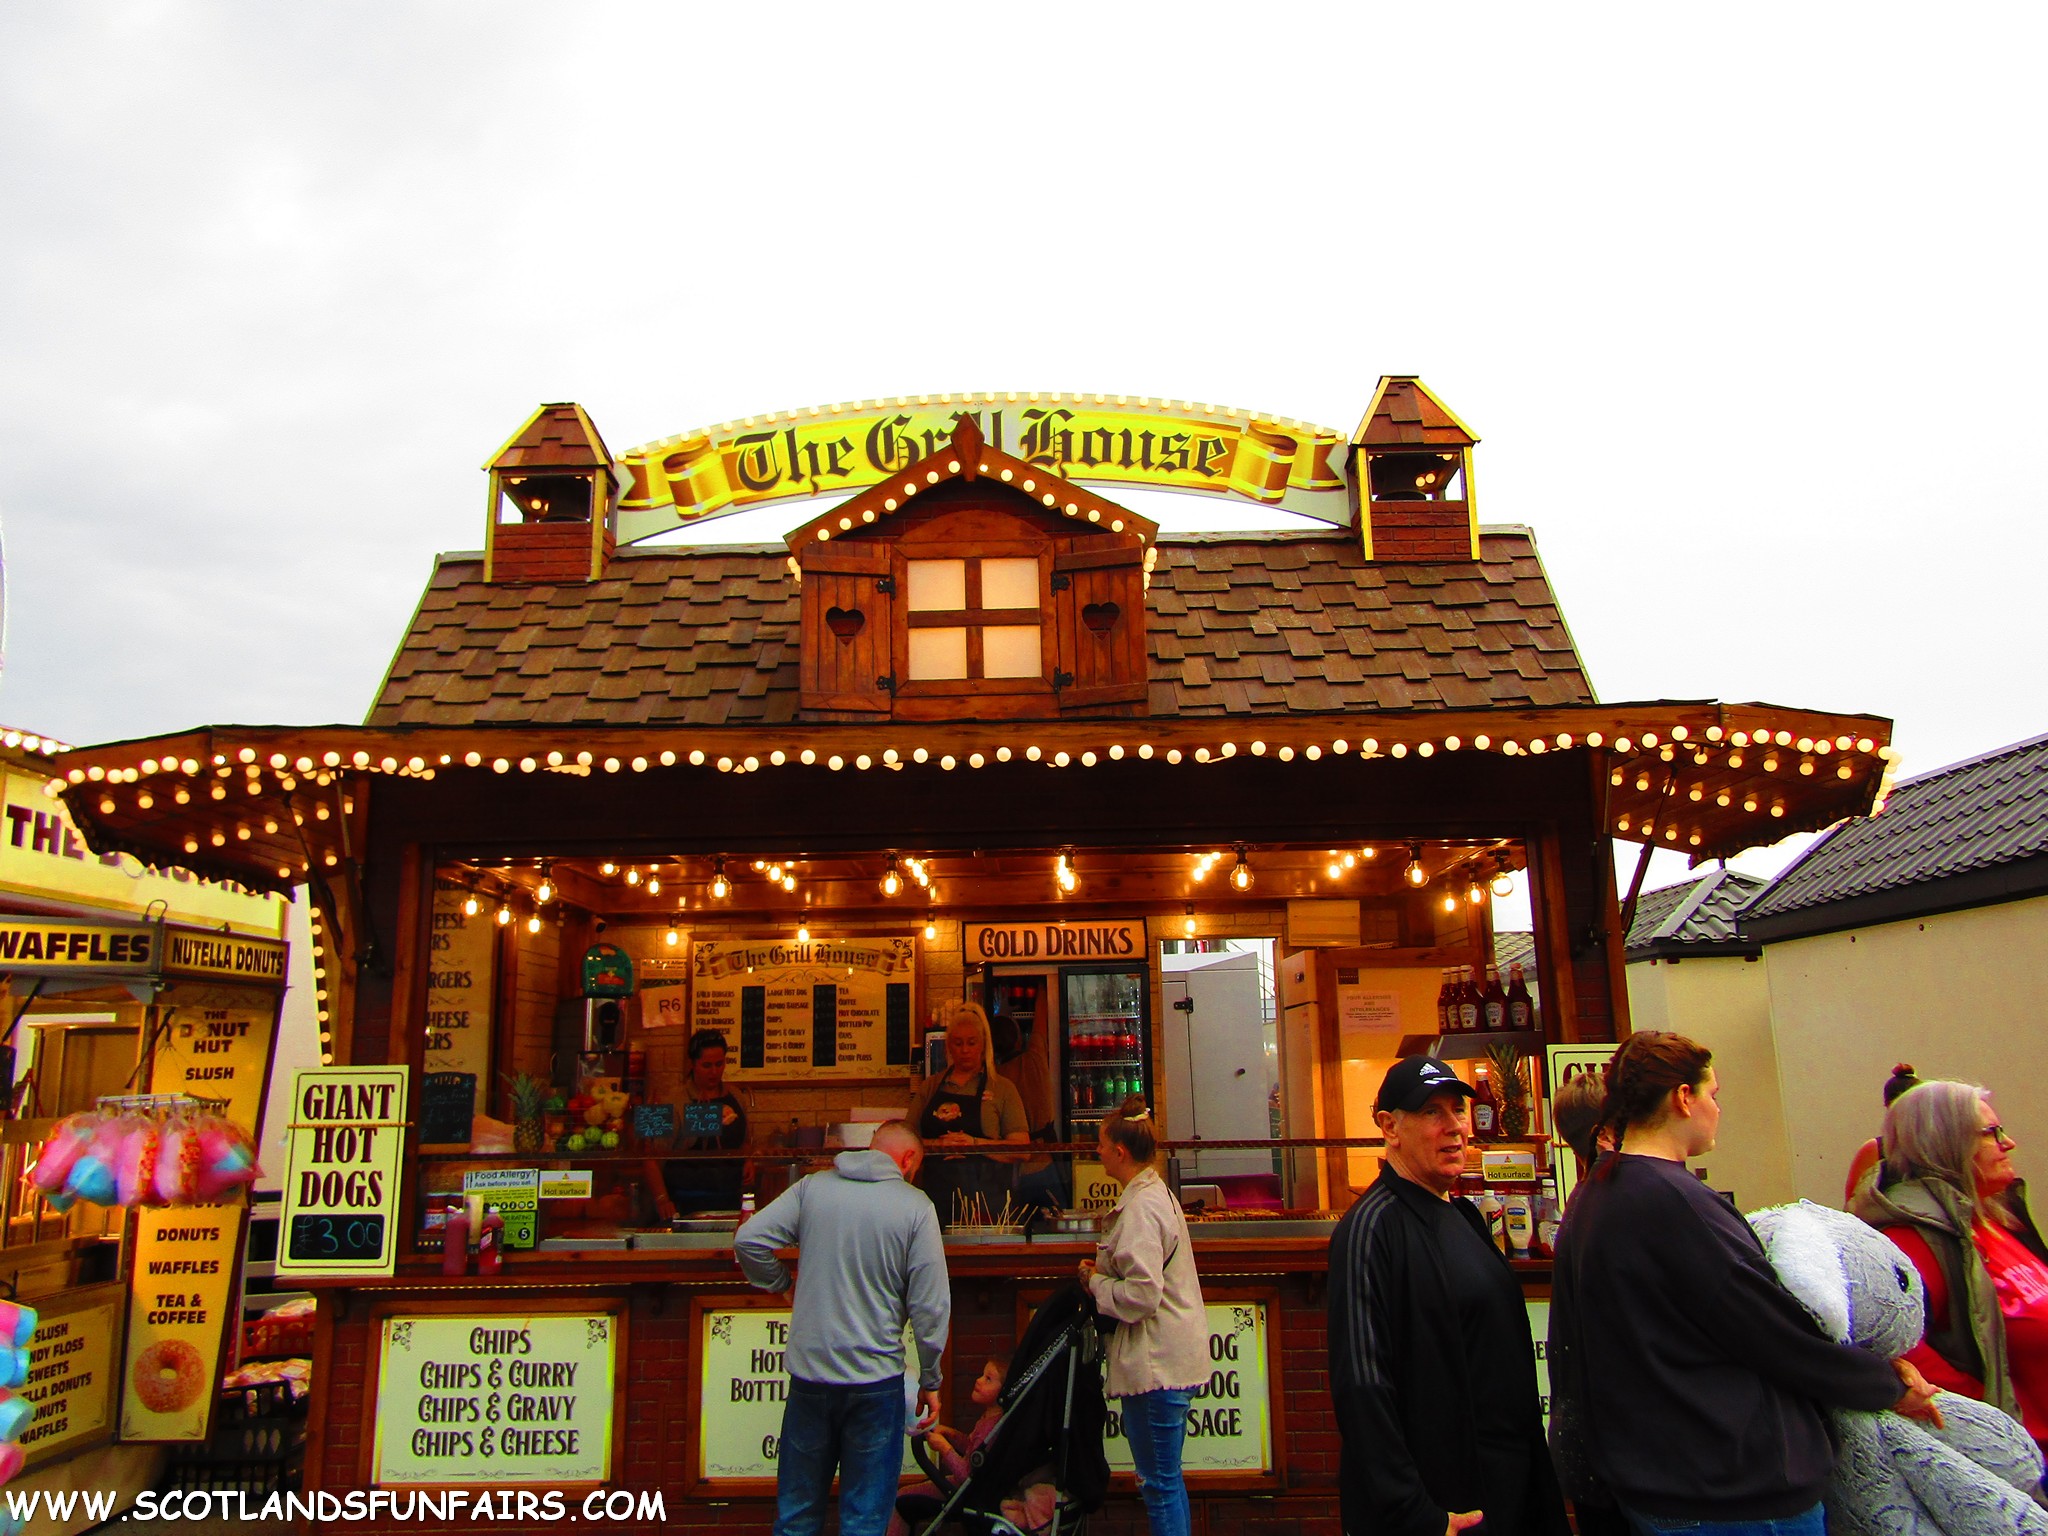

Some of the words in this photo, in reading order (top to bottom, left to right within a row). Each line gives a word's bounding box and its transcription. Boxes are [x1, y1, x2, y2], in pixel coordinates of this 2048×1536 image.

[733, 427, 855, 496] The
[1020, 408, 1228, 480] House
[6, 803, 84, 860] THE
[978, 928, 1039, 958] COLD
[1045, 926, 1134, 957] DRINKS
[172, 937, 233, 969] NUTELLA
[235, 945, 285, 976] DONUTS
[730, 950, 766, 970] The
[770, 944, 812, 966] Grill
[815, 943, 876, 968] House
[204, 1011, 228, 1020] THE
[659, 998, 681, 1013] R6
[193, 1040, 233, 1054] HUT
[185, 1067, 235, 1081] SLUSH
[303, 1084, 395, 1121] GIANT
[311, 1127, 378, 1163] HOT
[474, 1171, 498, 1180] Food
[499, 1169, 537, 1181] Allergy?
[508, 1180, 520, 1188] you
[1487, 1171, 1501, 1179] Hot
[1503, 1171, 1531, 1179] surface
[297, 1170, 384, 1208] DOGS
[1088, 1182, 1122, 1199] COL
[156, 1227, 220, 1242] DONUTS
[520, 1229, 529, 1240] 5
[148, 1261, 220, 1275] WAFFLES
[156, 1294, 186, 1308] TEA
[190, 1293, 202, 1308] &
[147, 1311, 207, 1325] COFFEE
[35, 1323, 69, 1343] SLUSH
[470, 1327, 532, 1354] CHIPS
[766, 1321, 788, 1345] TE
[30, 1346, 51, 1364] NDY
[53, 1337, 85, 1357] FLOSS
[1210, 1334, 1238, 1361] OG
[27, 1360, 70, 1384] SWEETS
[50, 1372, 93, 1396] DONUTS
[420, 1361, 482, 1389] CHIPS
[487, 1358, 503, 1389] &
[509, 1360, 579, 1388] CURRY
[731, 1378, 787, 1403] BOTTL
[418, 1394, 481, 1423] CHIPS
[486, 1392, 501, 1424] &
[507, 1393, 577, 1422] GRAVY
[20, 1417, 69, 1445] WAFFLES
[1187, 1408, 1243, 1438] SAGE
[412, 1428, 475, 1457] CHIPS
[480, 1426, 496, 1458] &
[501, 1427, 580, 1456] CHEESE
